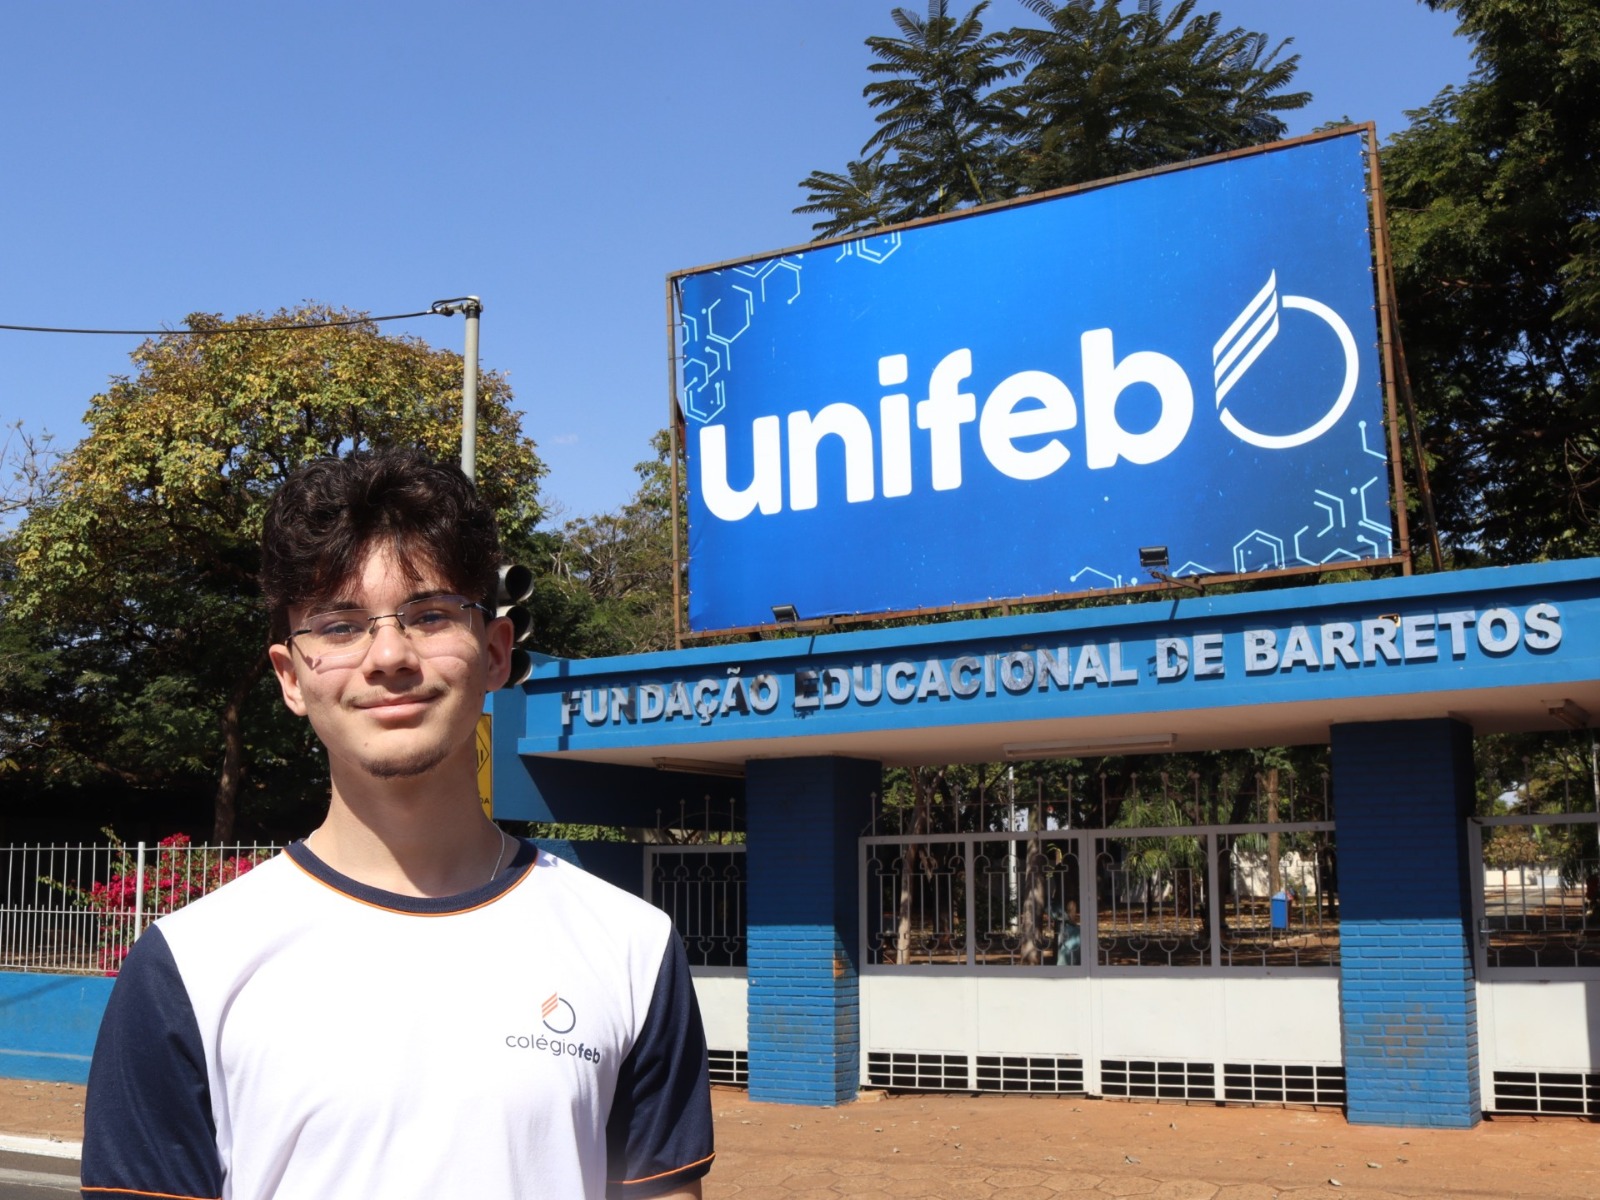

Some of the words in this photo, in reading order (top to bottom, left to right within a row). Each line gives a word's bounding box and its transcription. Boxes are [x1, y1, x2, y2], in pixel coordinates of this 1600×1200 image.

[700, 327, 1194, 522] unifeb
[561, 667, 780, 725] FUNDAÇÃO
[794, 641, 1139, 708] EDUCACIONAL
[1155, 633, 1225, 679] DE
[1244, 603, 1562, 672] BARRETOS
